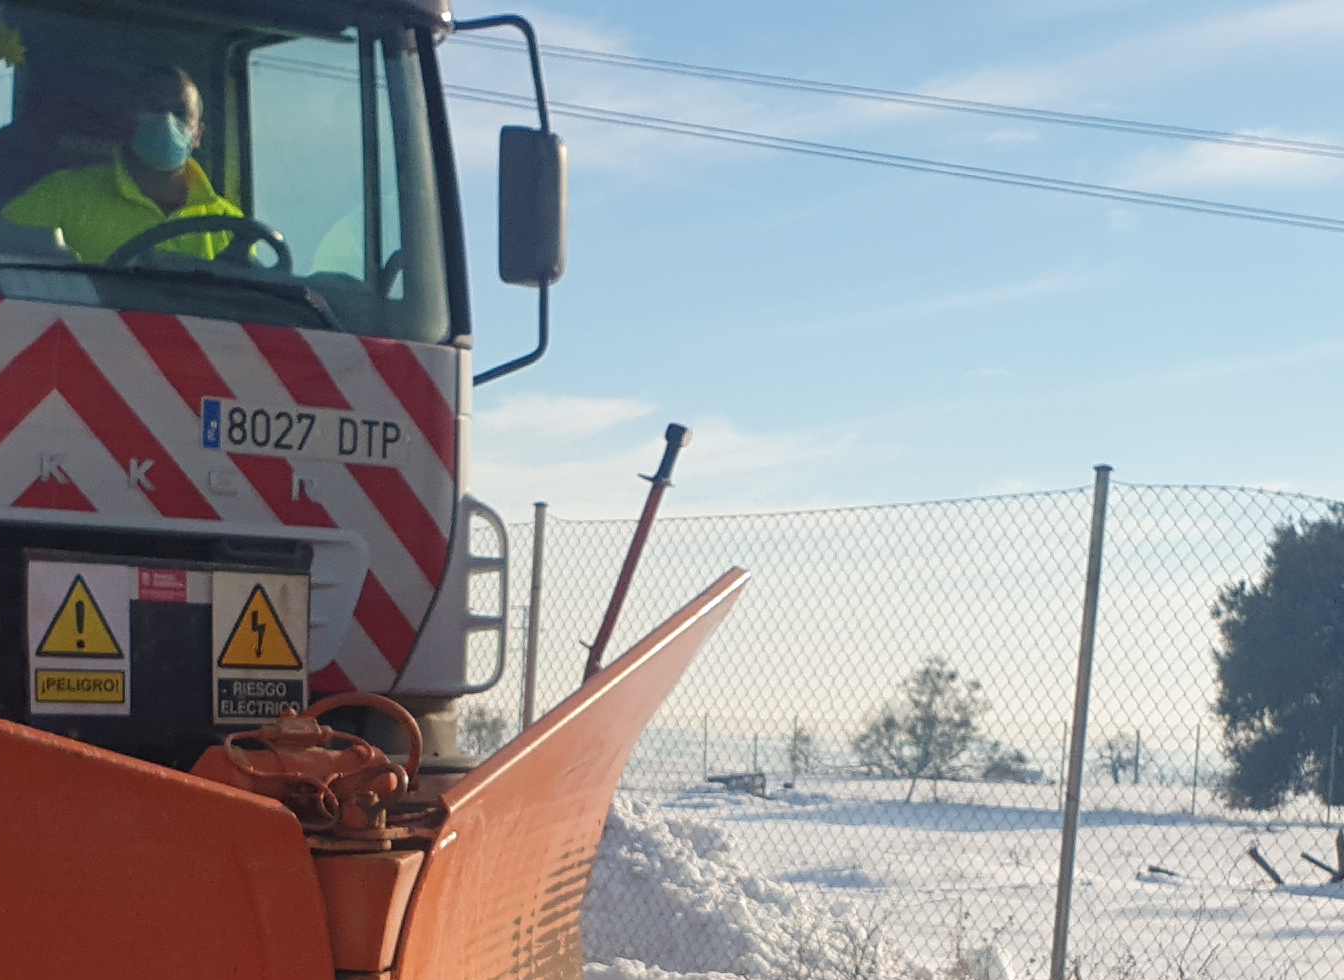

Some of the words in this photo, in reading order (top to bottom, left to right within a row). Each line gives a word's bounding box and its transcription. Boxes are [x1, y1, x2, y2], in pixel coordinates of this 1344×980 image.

[227, 406, 316, 452] 8027
[338, 417, 402, 459] DTP
[41, 677, 119, 694] ¡PELIGRO!
[233, 681, 288, 697] RIESGO
